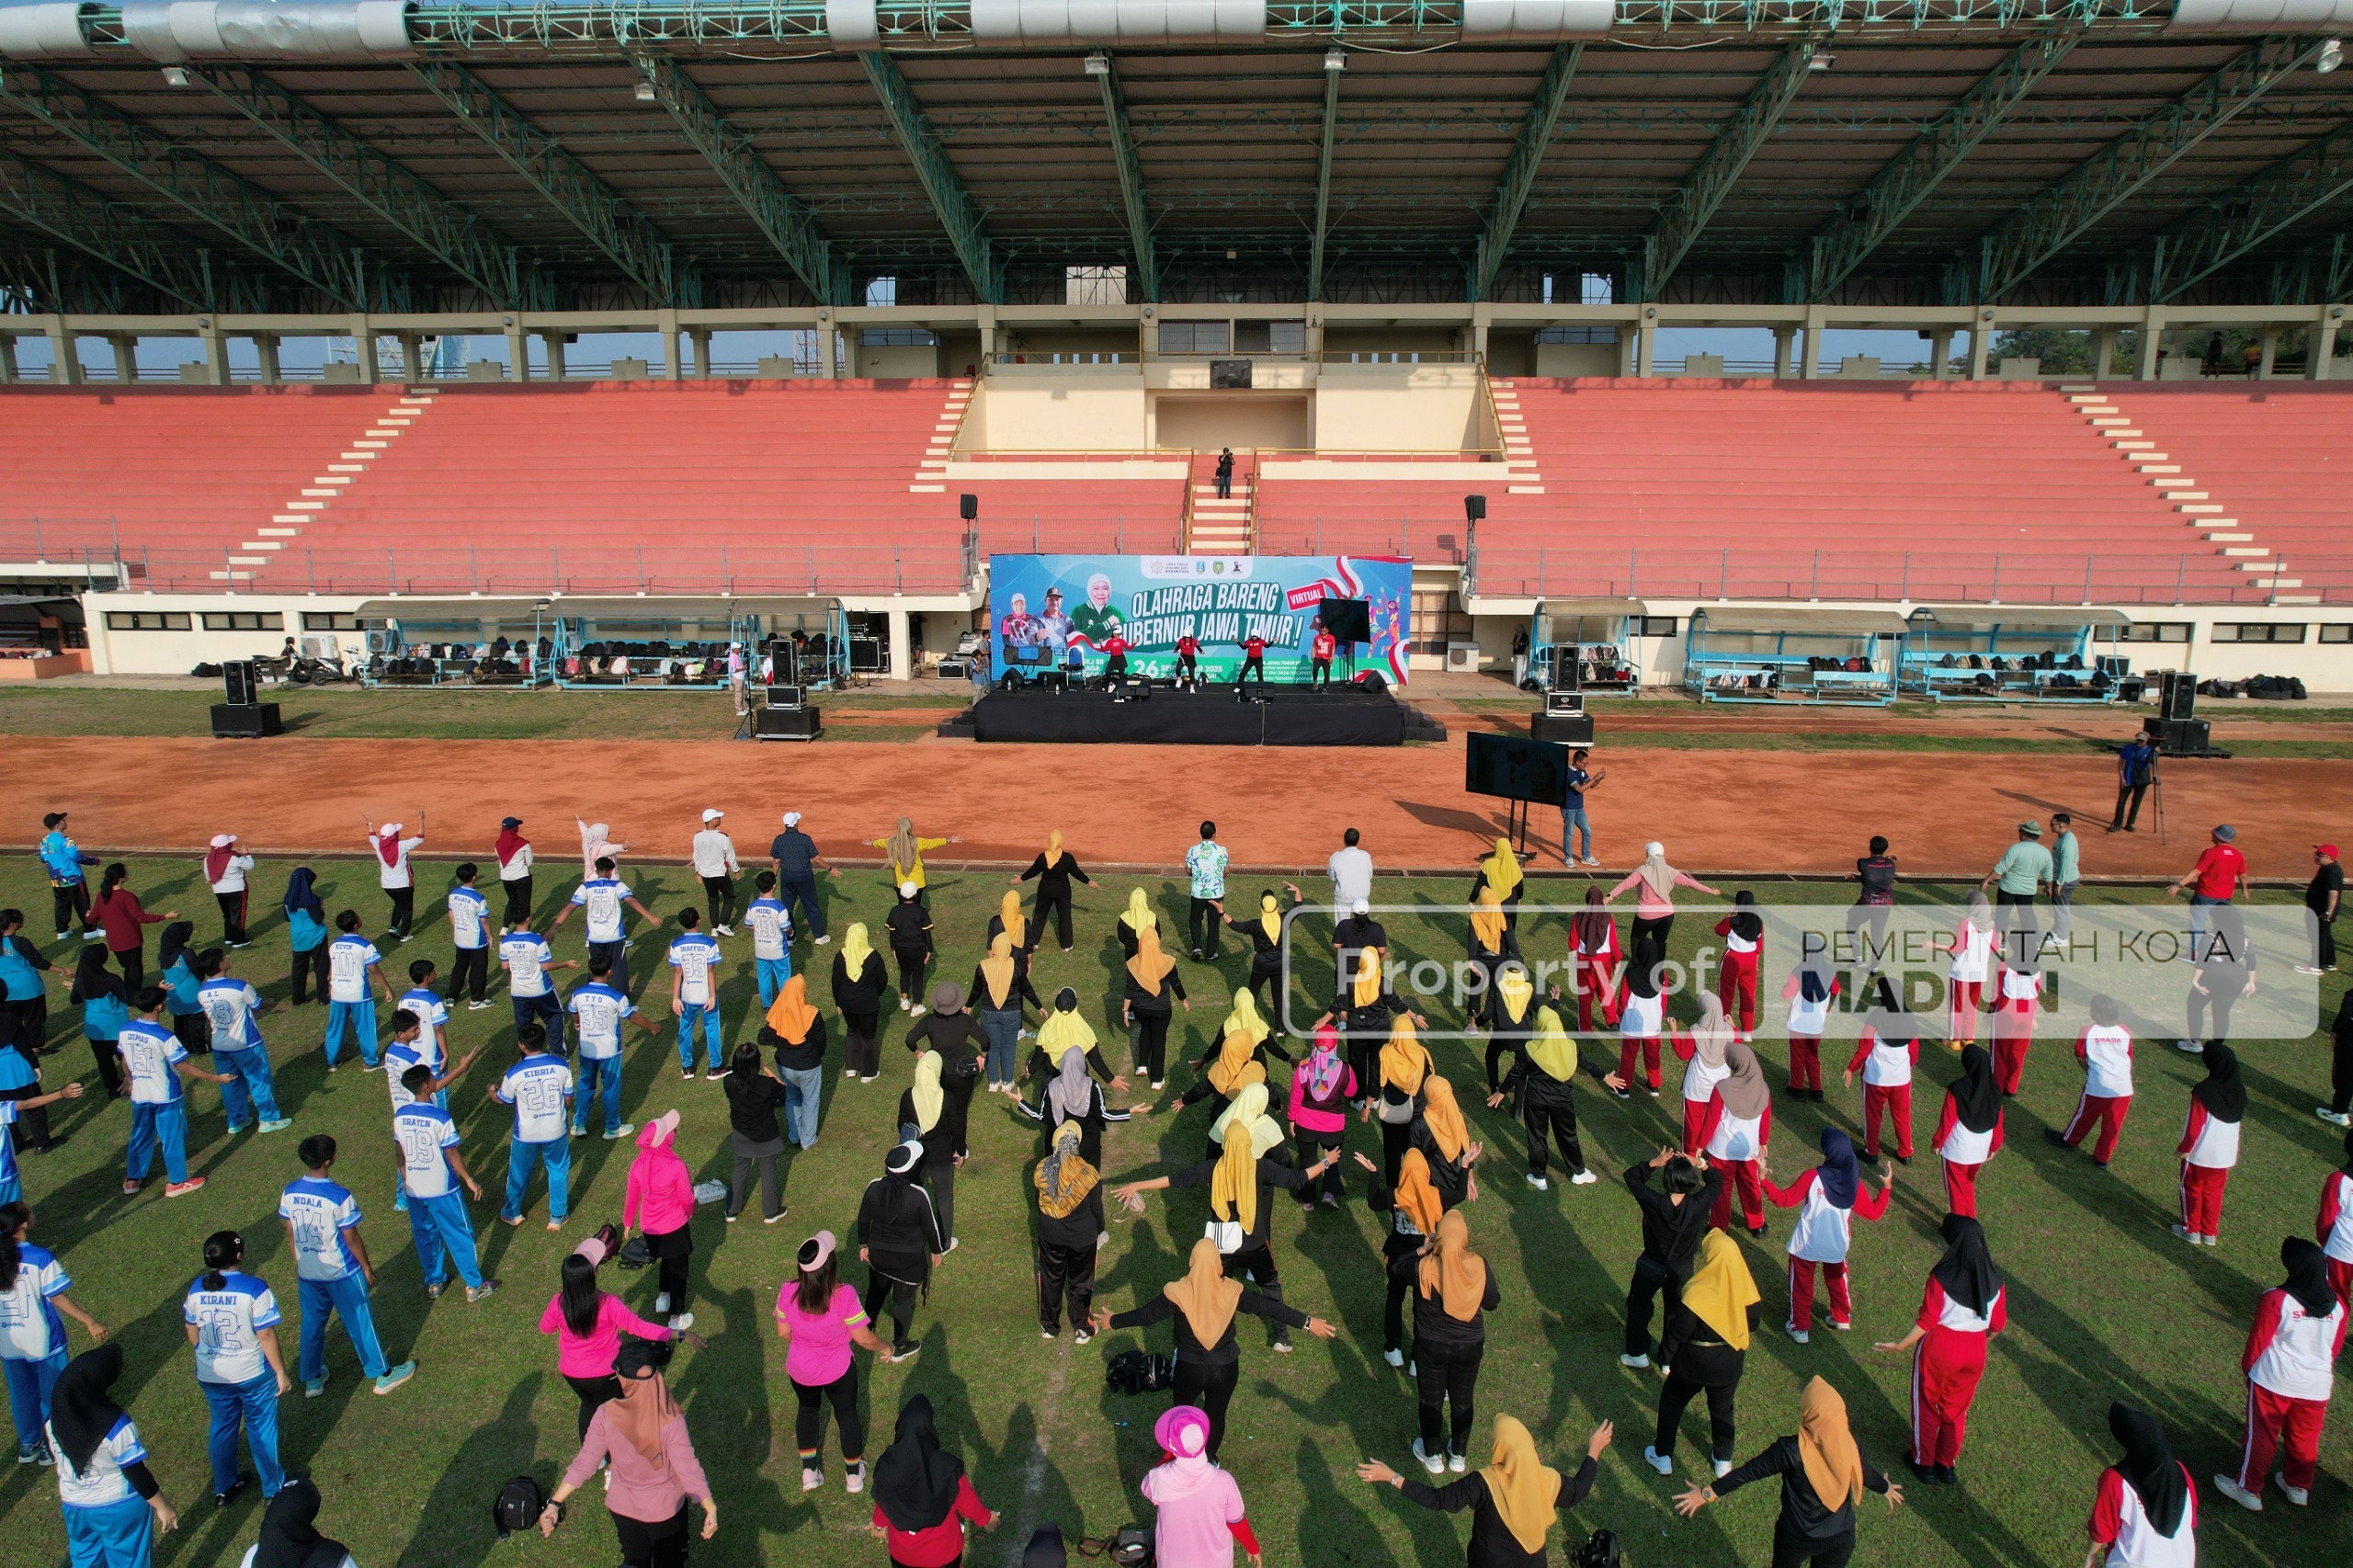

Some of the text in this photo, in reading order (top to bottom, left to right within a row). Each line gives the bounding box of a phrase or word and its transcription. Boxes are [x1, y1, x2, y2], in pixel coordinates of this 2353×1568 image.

[1131, 583, 1279, 619] OLAHRAGA BARENG
[1290, 589, 1323, 605] VIRTUAL
[1199, 613, 1239, 641] JAWA
[1133, 660, 1159, 677] 26
[581, 1004, 609, 1030] 35
[128, 1033, 150, 1044] DIMAS
[524, 1067, 557, 1078] KIBRIA
[523, 1077, 561, 1110] 26
[403, 1118, 431, 1128] BRAYEN
[404, 1129, 435, 1164] 09
[293, 1196, 323, 1208] NDALA
[292, 1208, 324, 1246] 14
[199, 1295, 238, 1306] KIRANI
[200, 1309, 243, 1350] 12
